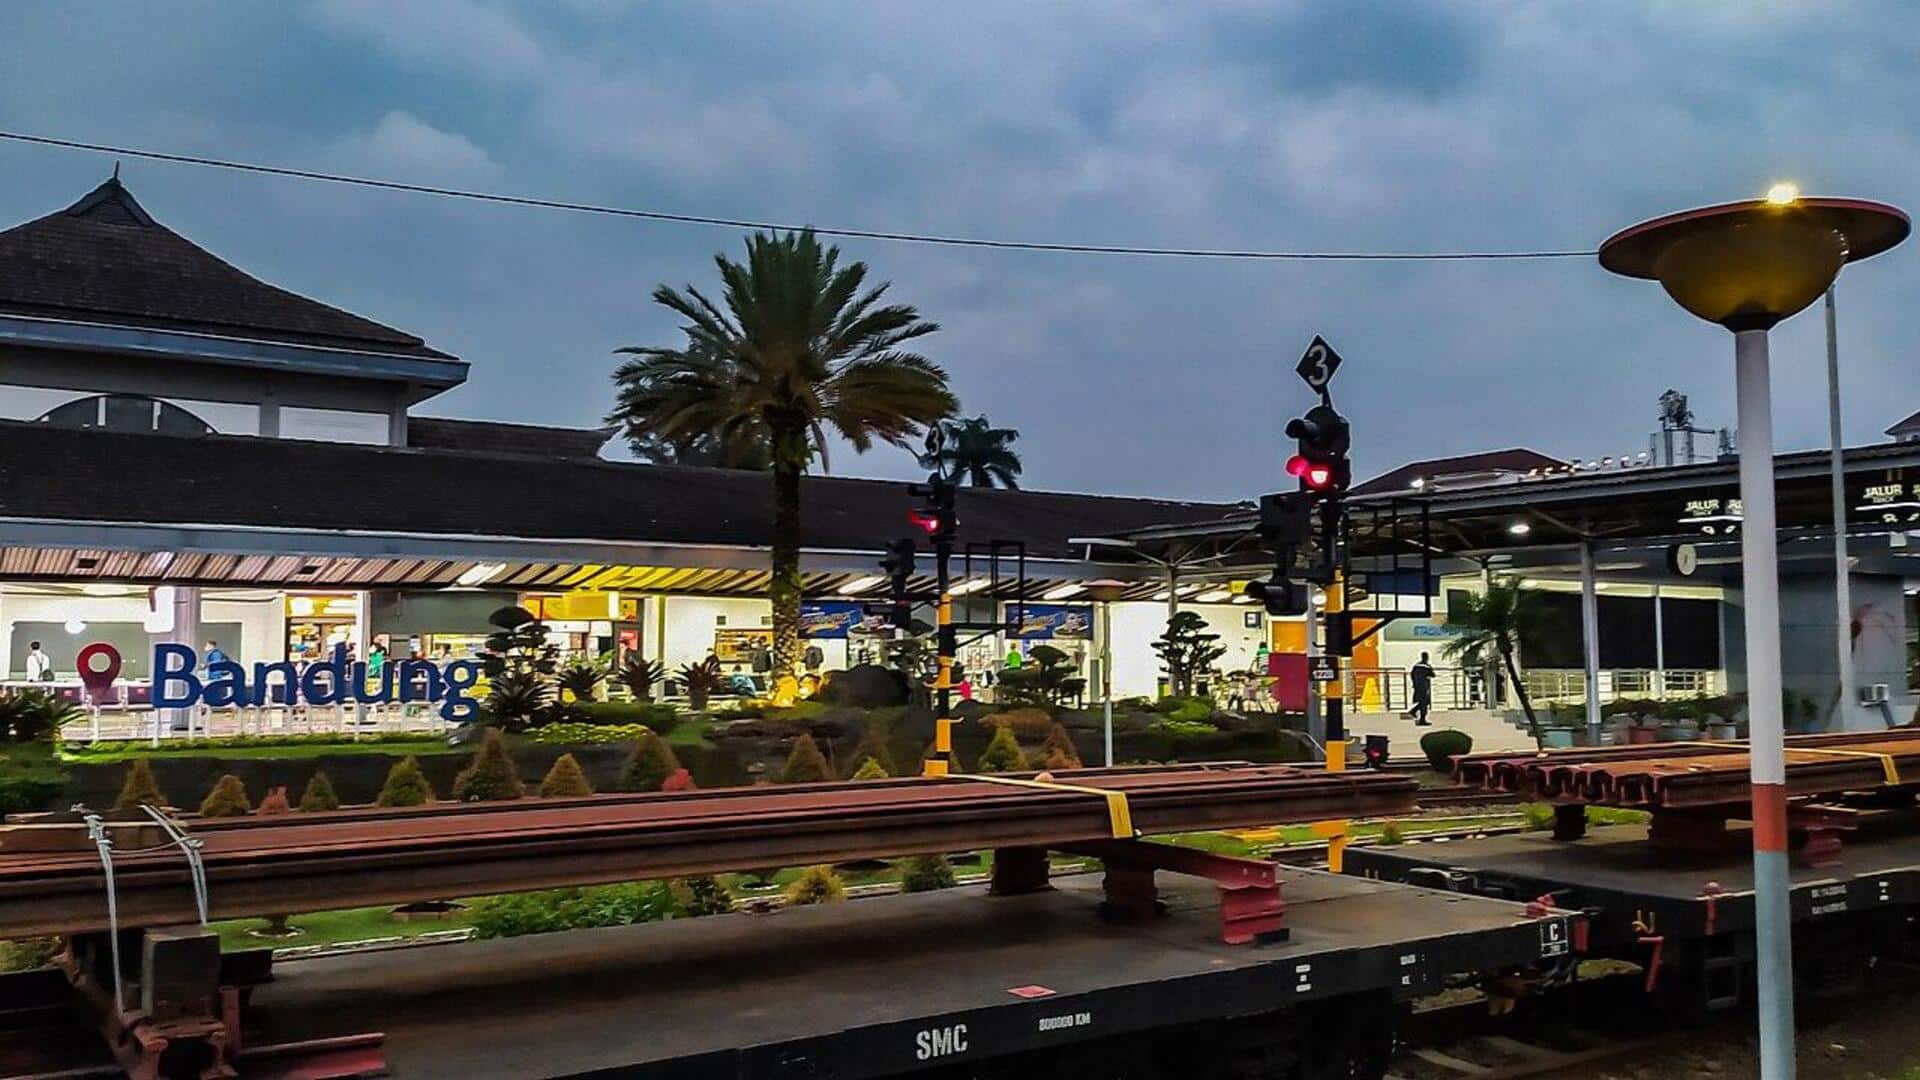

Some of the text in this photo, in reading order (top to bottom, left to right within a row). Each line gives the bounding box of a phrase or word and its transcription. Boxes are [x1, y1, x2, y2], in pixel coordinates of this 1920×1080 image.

[1308, 344, 1329, 386] 3
[930, 426, 940, 457] 3
[1684, 499, 1720, 512] JALUR
[1863, 484, 1903, 500] JALUR
[152, 641, 485, 723] Bandung
[1550, 923, 1559, 941] C
[916, 1023, 969, 1061] SMC
